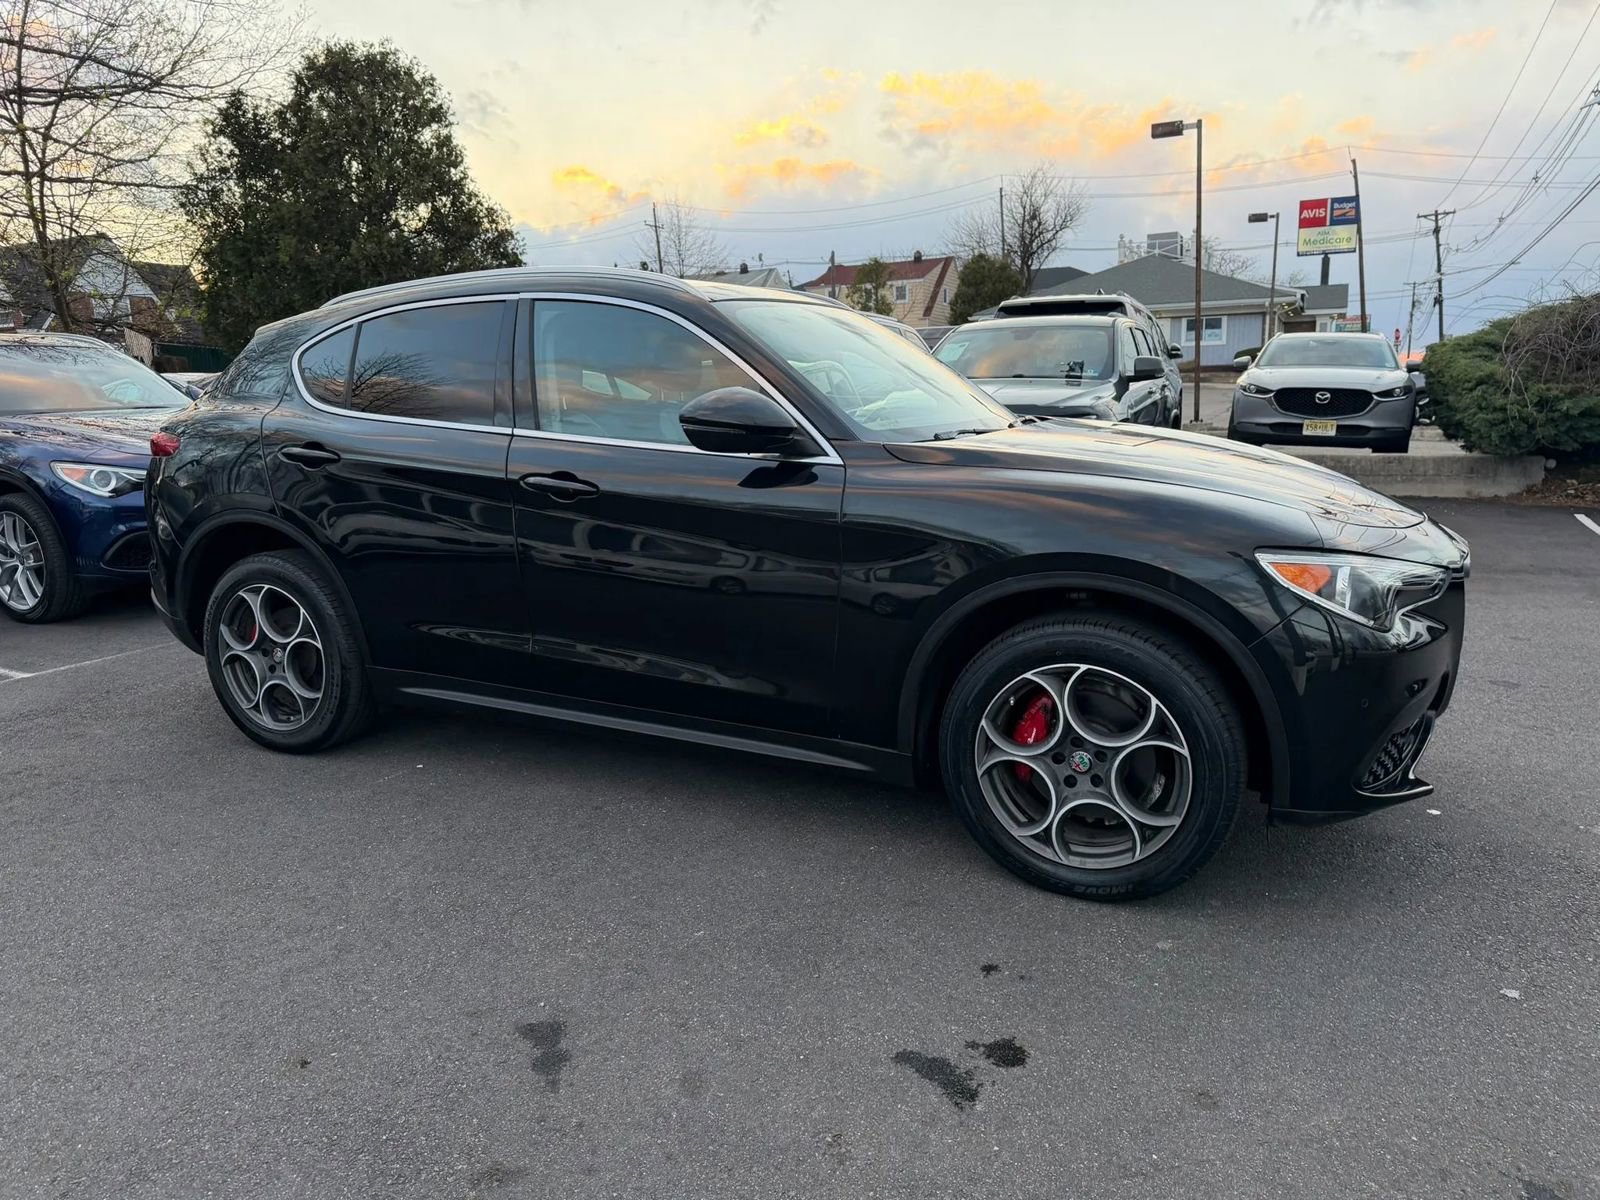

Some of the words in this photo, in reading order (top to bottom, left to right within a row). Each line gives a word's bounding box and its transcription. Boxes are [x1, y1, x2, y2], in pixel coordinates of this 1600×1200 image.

[1333, 202, 1356, 210] Budget
[1300, 208, 1326, 219] AVIS
[1302, 236, 1352, 247] Medicare
